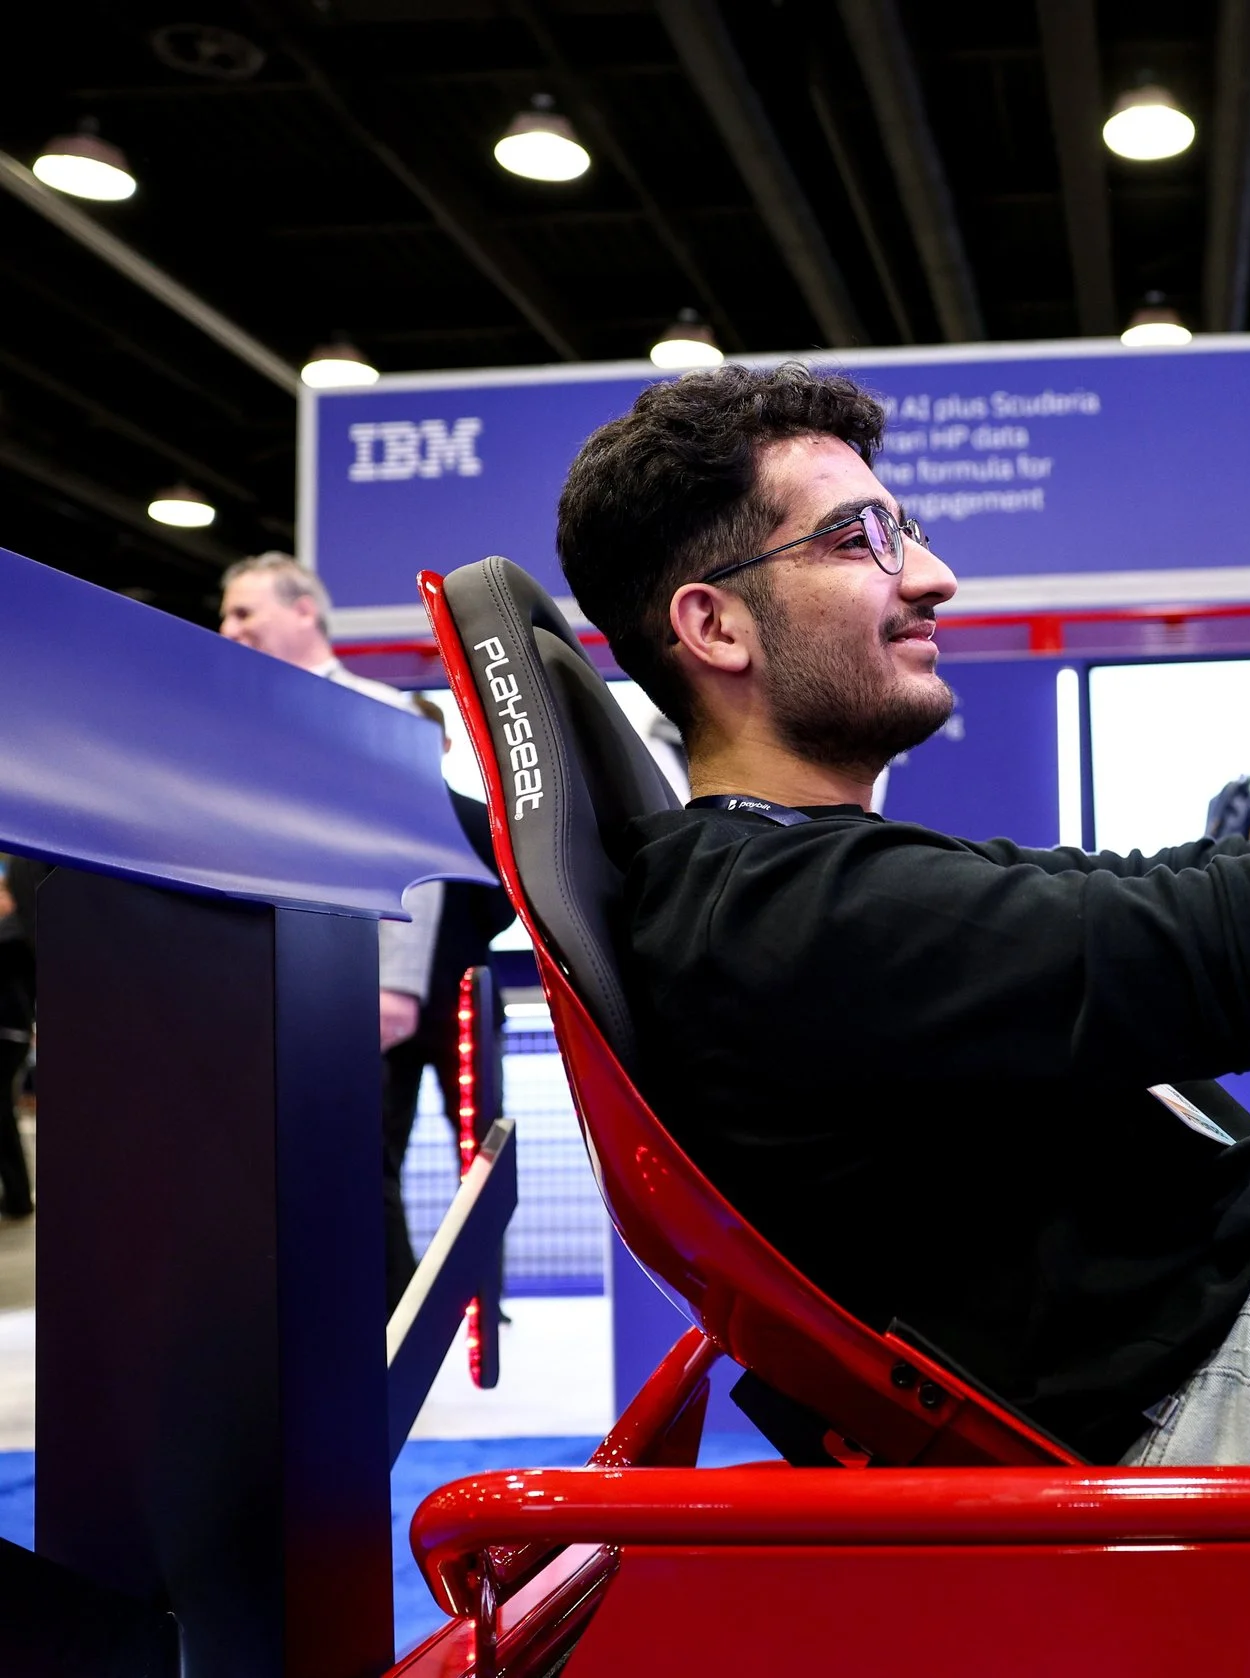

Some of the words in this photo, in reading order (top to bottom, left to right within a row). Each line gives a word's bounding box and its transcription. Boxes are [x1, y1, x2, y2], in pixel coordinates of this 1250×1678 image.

[934, 397, 987, 422] plus
[991, 392, 1100, 417] Scuderia
[350, 418, 481, 481] IBM
[930, 426, 968, 450] HP
[971, 424, 1029, 450] data
[917, 457, 1014, 483] formula
[1017, 453, 1051, 479] for
